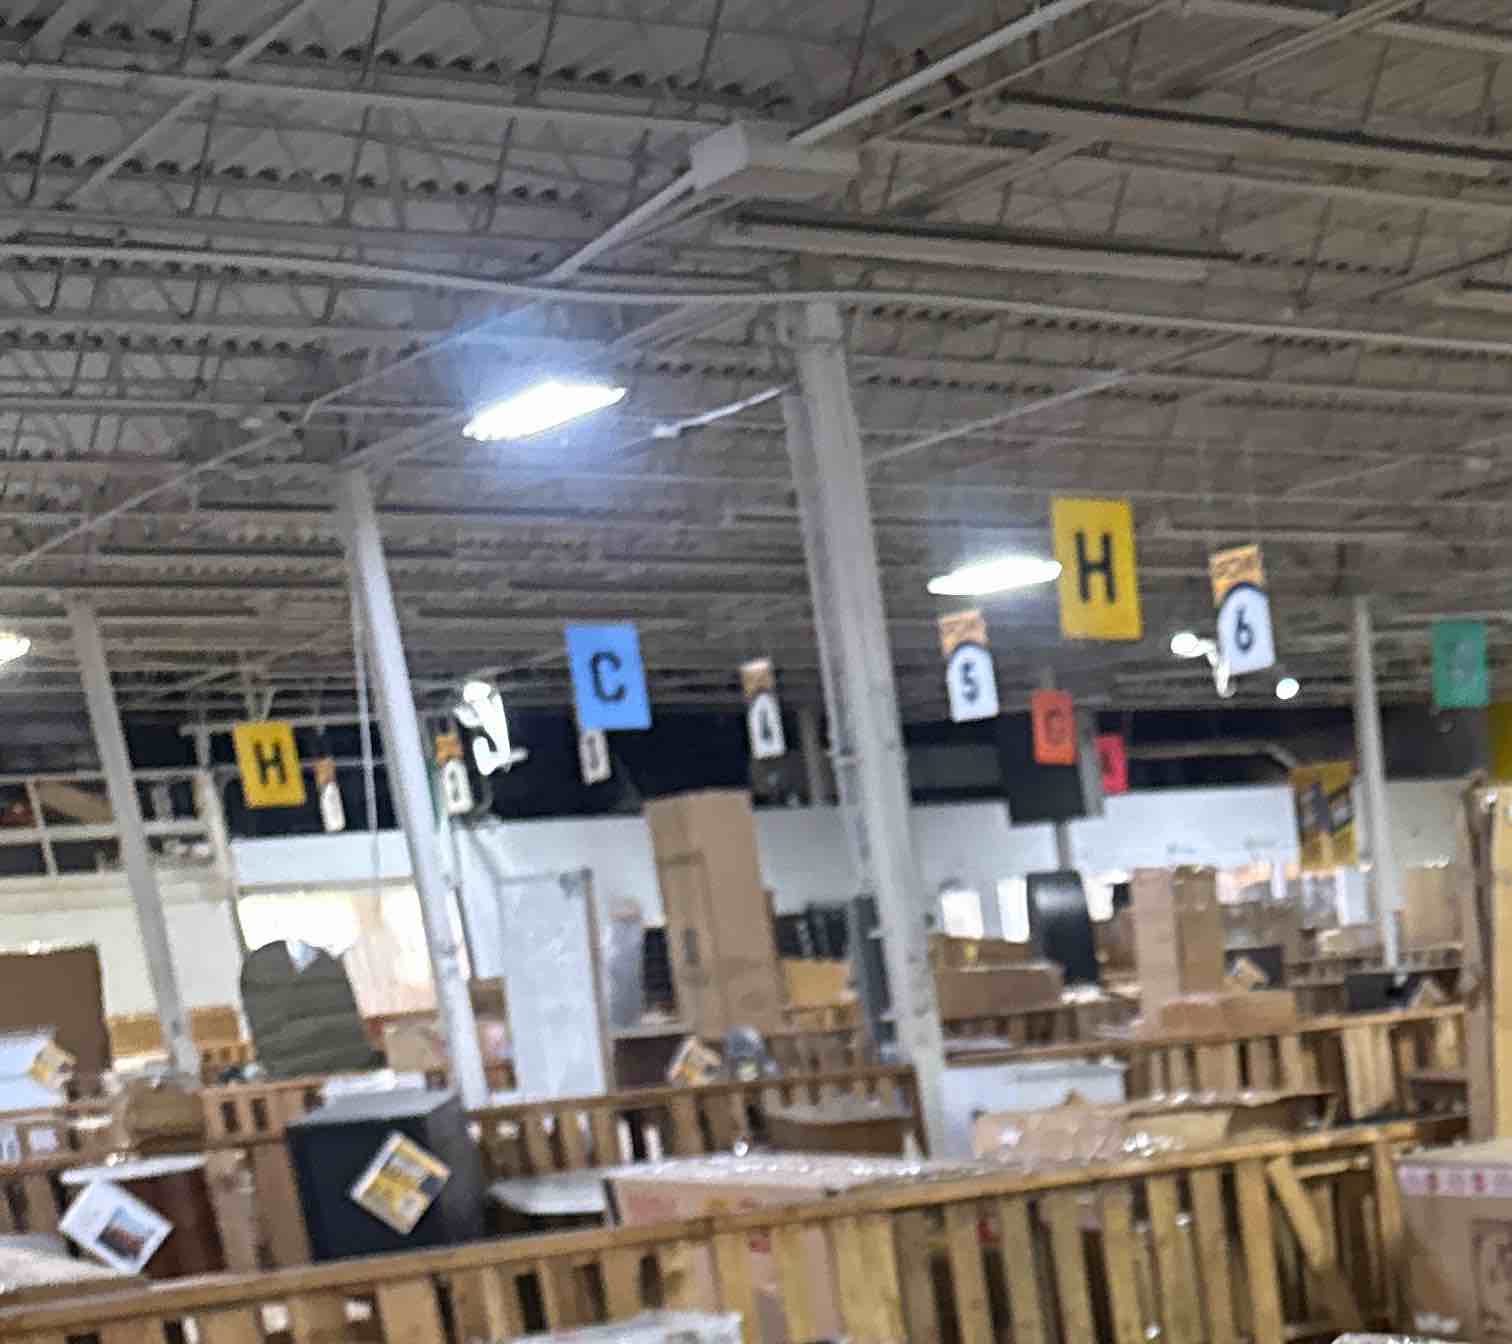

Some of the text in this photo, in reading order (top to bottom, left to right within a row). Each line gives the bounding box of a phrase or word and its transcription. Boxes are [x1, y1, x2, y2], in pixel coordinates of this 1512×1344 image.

[1074, 530, 1117, 604] H
[1233, 604, 1255, 653] 6
[589, 651, 628, 703] C
[959, 660, 980, 704] 5
[252, 739, 288, 786] H
